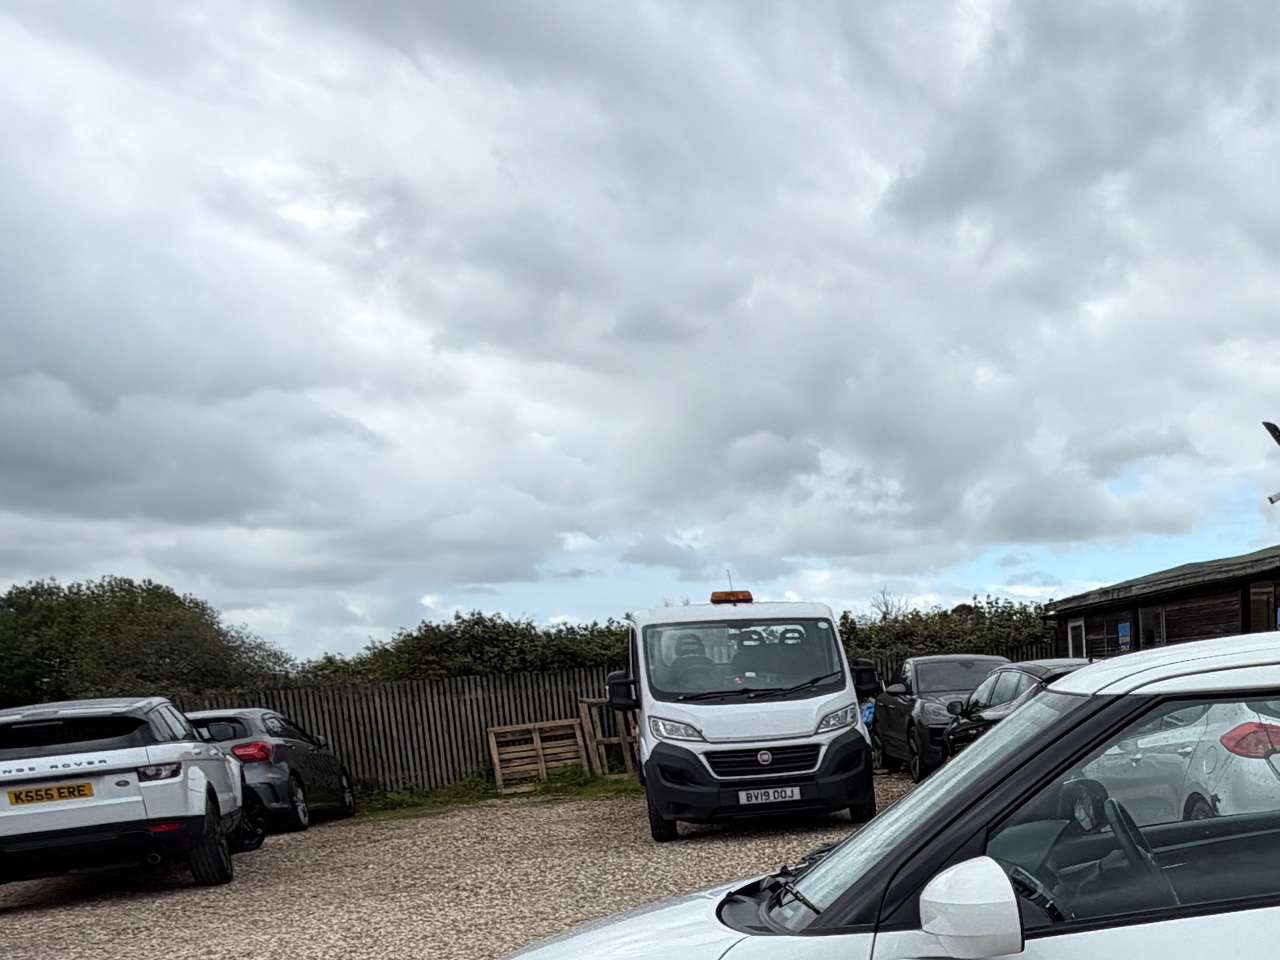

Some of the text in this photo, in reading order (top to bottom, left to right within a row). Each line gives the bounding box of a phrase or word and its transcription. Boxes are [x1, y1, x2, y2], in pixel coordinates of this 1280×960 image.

[49, 759, 108, 770] ROVER
[14, 785, 88, 804] K555 ERE
[745, 791, 770, 803] BV19
